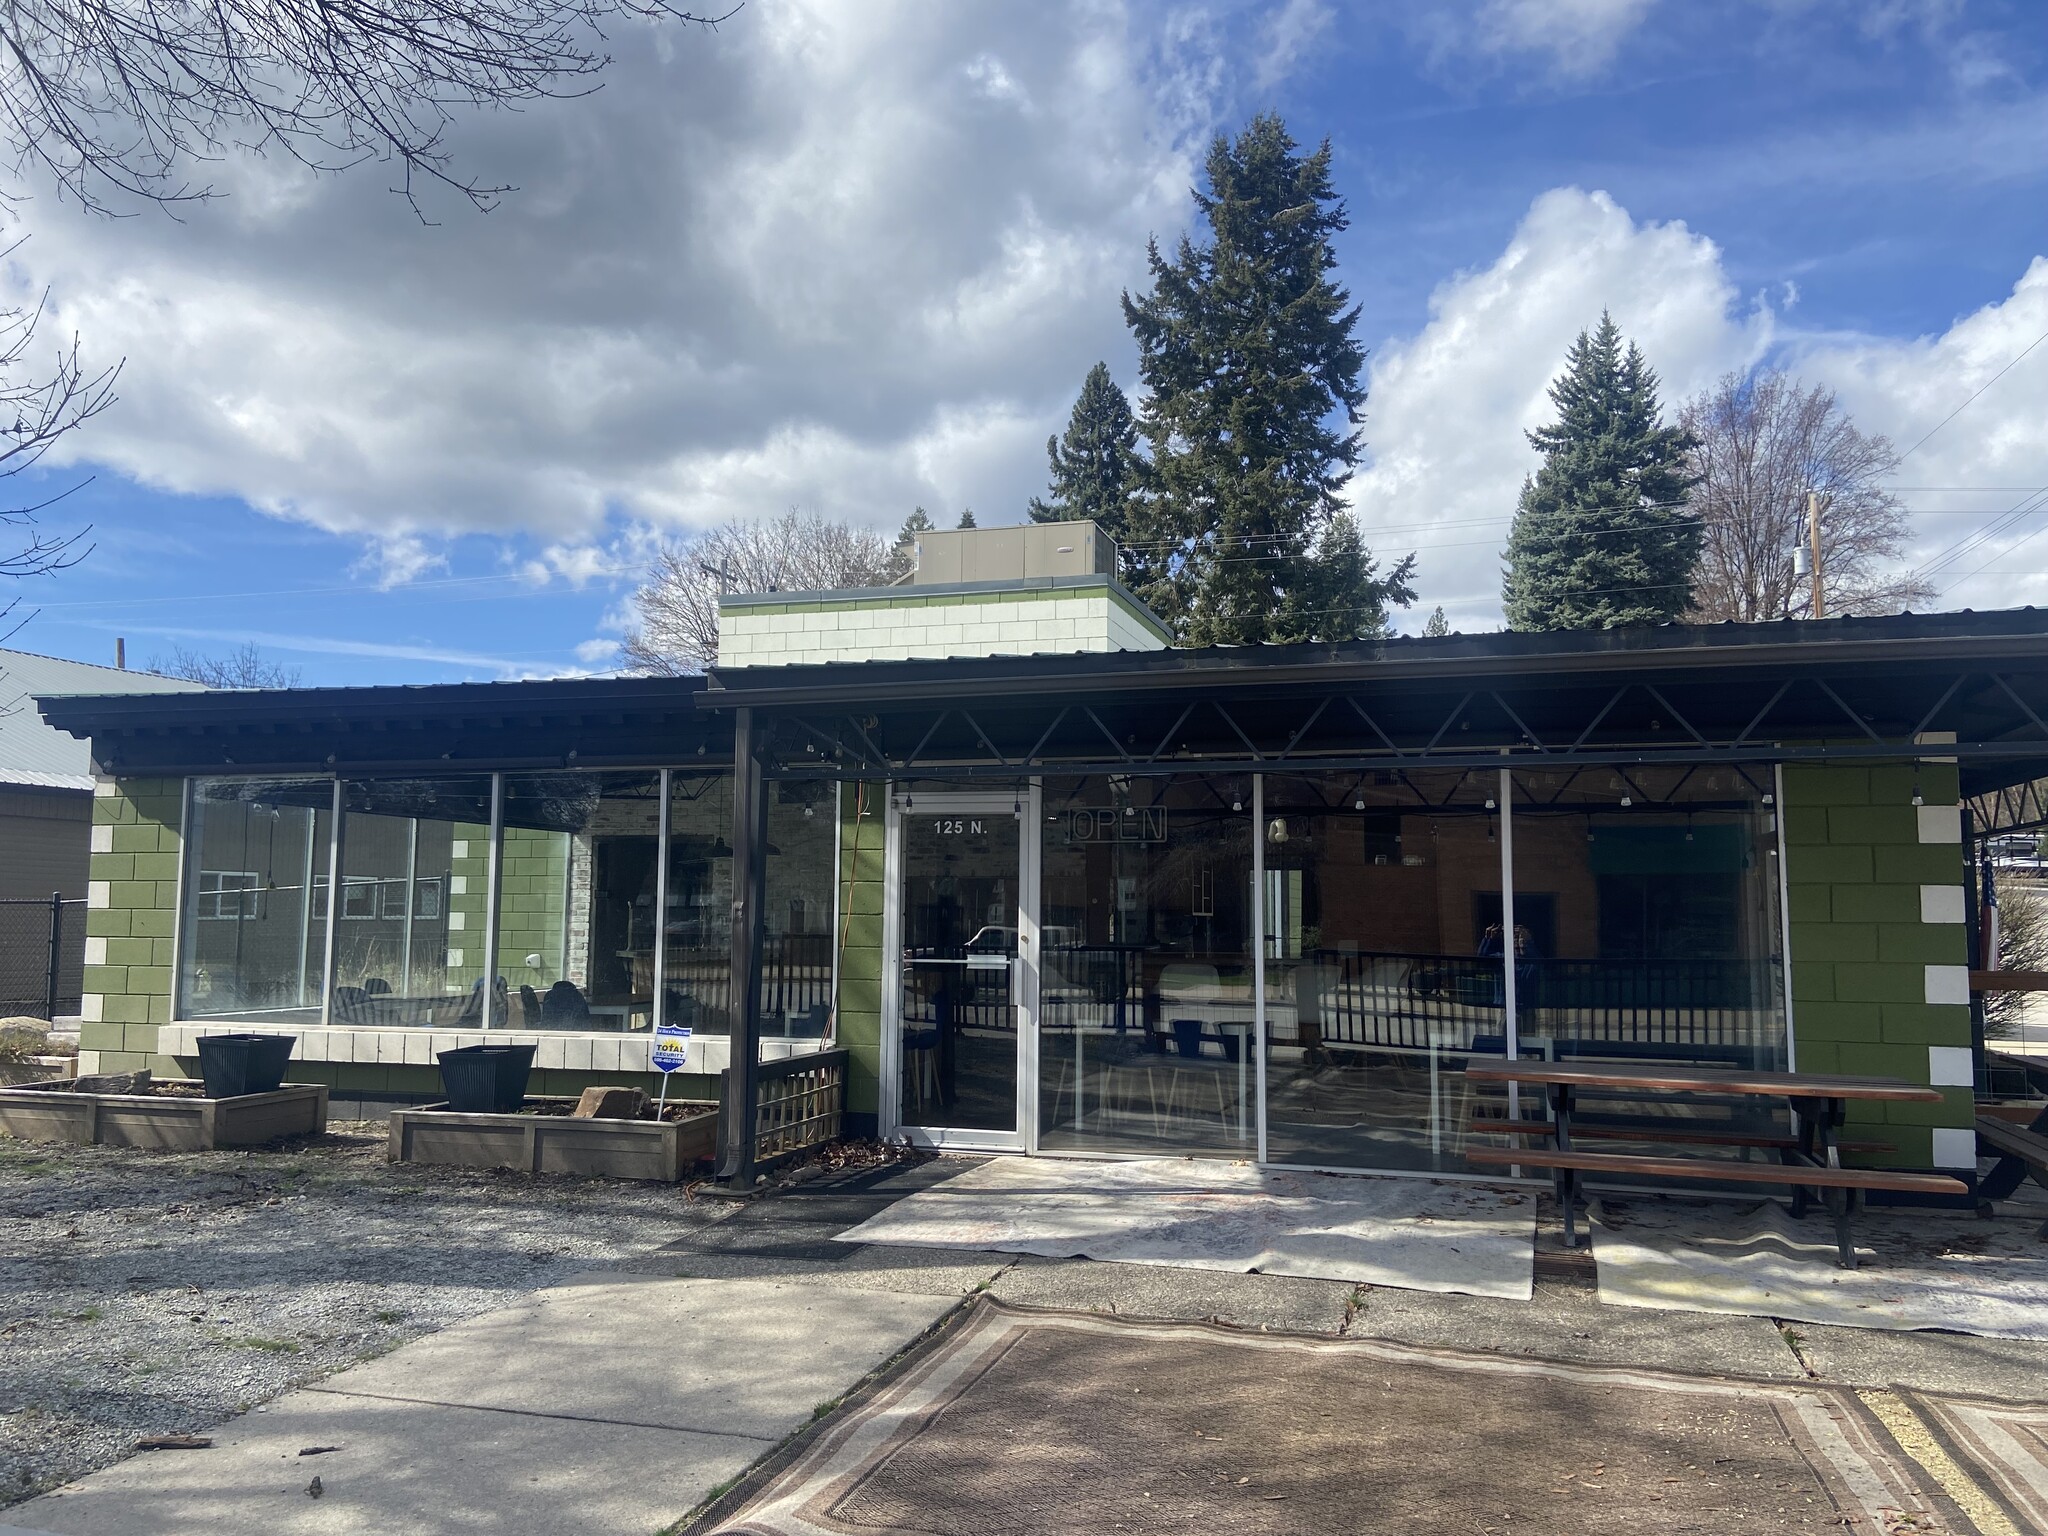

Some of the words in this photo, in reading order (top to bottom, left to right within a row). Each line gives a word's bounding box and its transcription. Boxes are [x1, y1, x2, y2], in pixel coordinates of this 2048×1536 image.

[934, 820, 963, 834] 125
[971, 821, 988, 834] N.
[1072, 809, 1163, 840] OPEN
